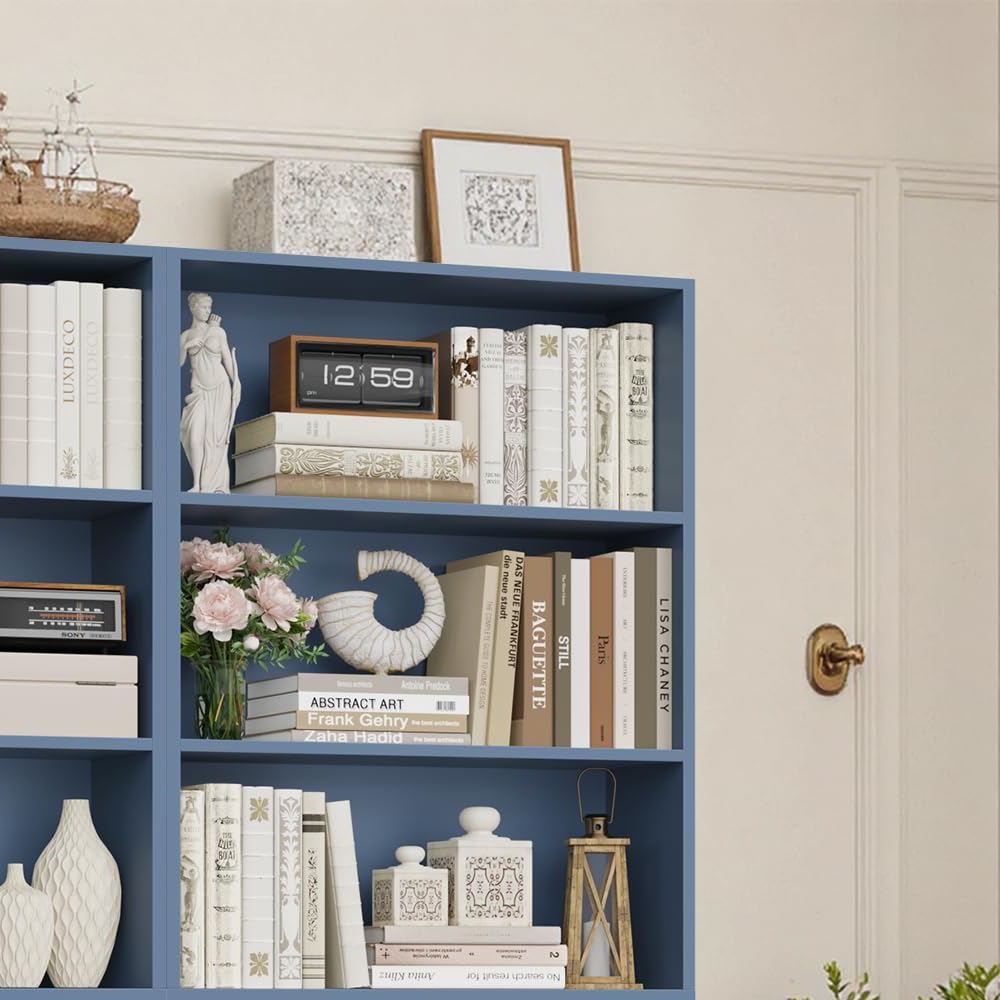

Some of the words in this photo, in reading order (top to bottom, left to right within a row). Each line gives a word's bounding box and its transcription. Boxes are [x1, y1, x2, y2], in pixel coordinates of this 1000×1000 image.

[63, 320, 74, 403] LUXDECO
[86, 321, 98, 404] LUXDECO
[324, 364, 354, 386] 12
[370, 366, 414, 388] 59
[504, 555, 512, 568] die
[515, 556, 524, 578] DAS
[502, 572, 510, 594] neue
[512, 580, 522, 607] NEUE
[500, 596, 508, 620] stadt
[660, 598, 670, 635] LISA
[482, 612, 492, 641] COMPLETE
[508, 610, 520, 668] FRANKFURT
[598, 635, 610, 665] Paris
[482, 644, 490, 660] GUIDE
[532, 600, 546, 710] BAGUETTE
[558, 636, 570, 670] STILL
[480, 670, 488, 686] HOME
[660, 644, 670, 712] CHANEY
[310, 697, 376, 709] ABSTRACT
[379, 699, 404, 710] ART
[478, 688, 486, 710] DESIGN
[307, 712, 354, 726] Frank
[358, 714, 409, 730] Gehry
[303, 730, 346, 742] Zaha
[354, 731, 404, 744] Hadid
[379, 972, 405, 980] Klinz
[408, 972, 435, 980] Anita
[482, 973, 510, 981] result
[512, 973, 544, 981] search
